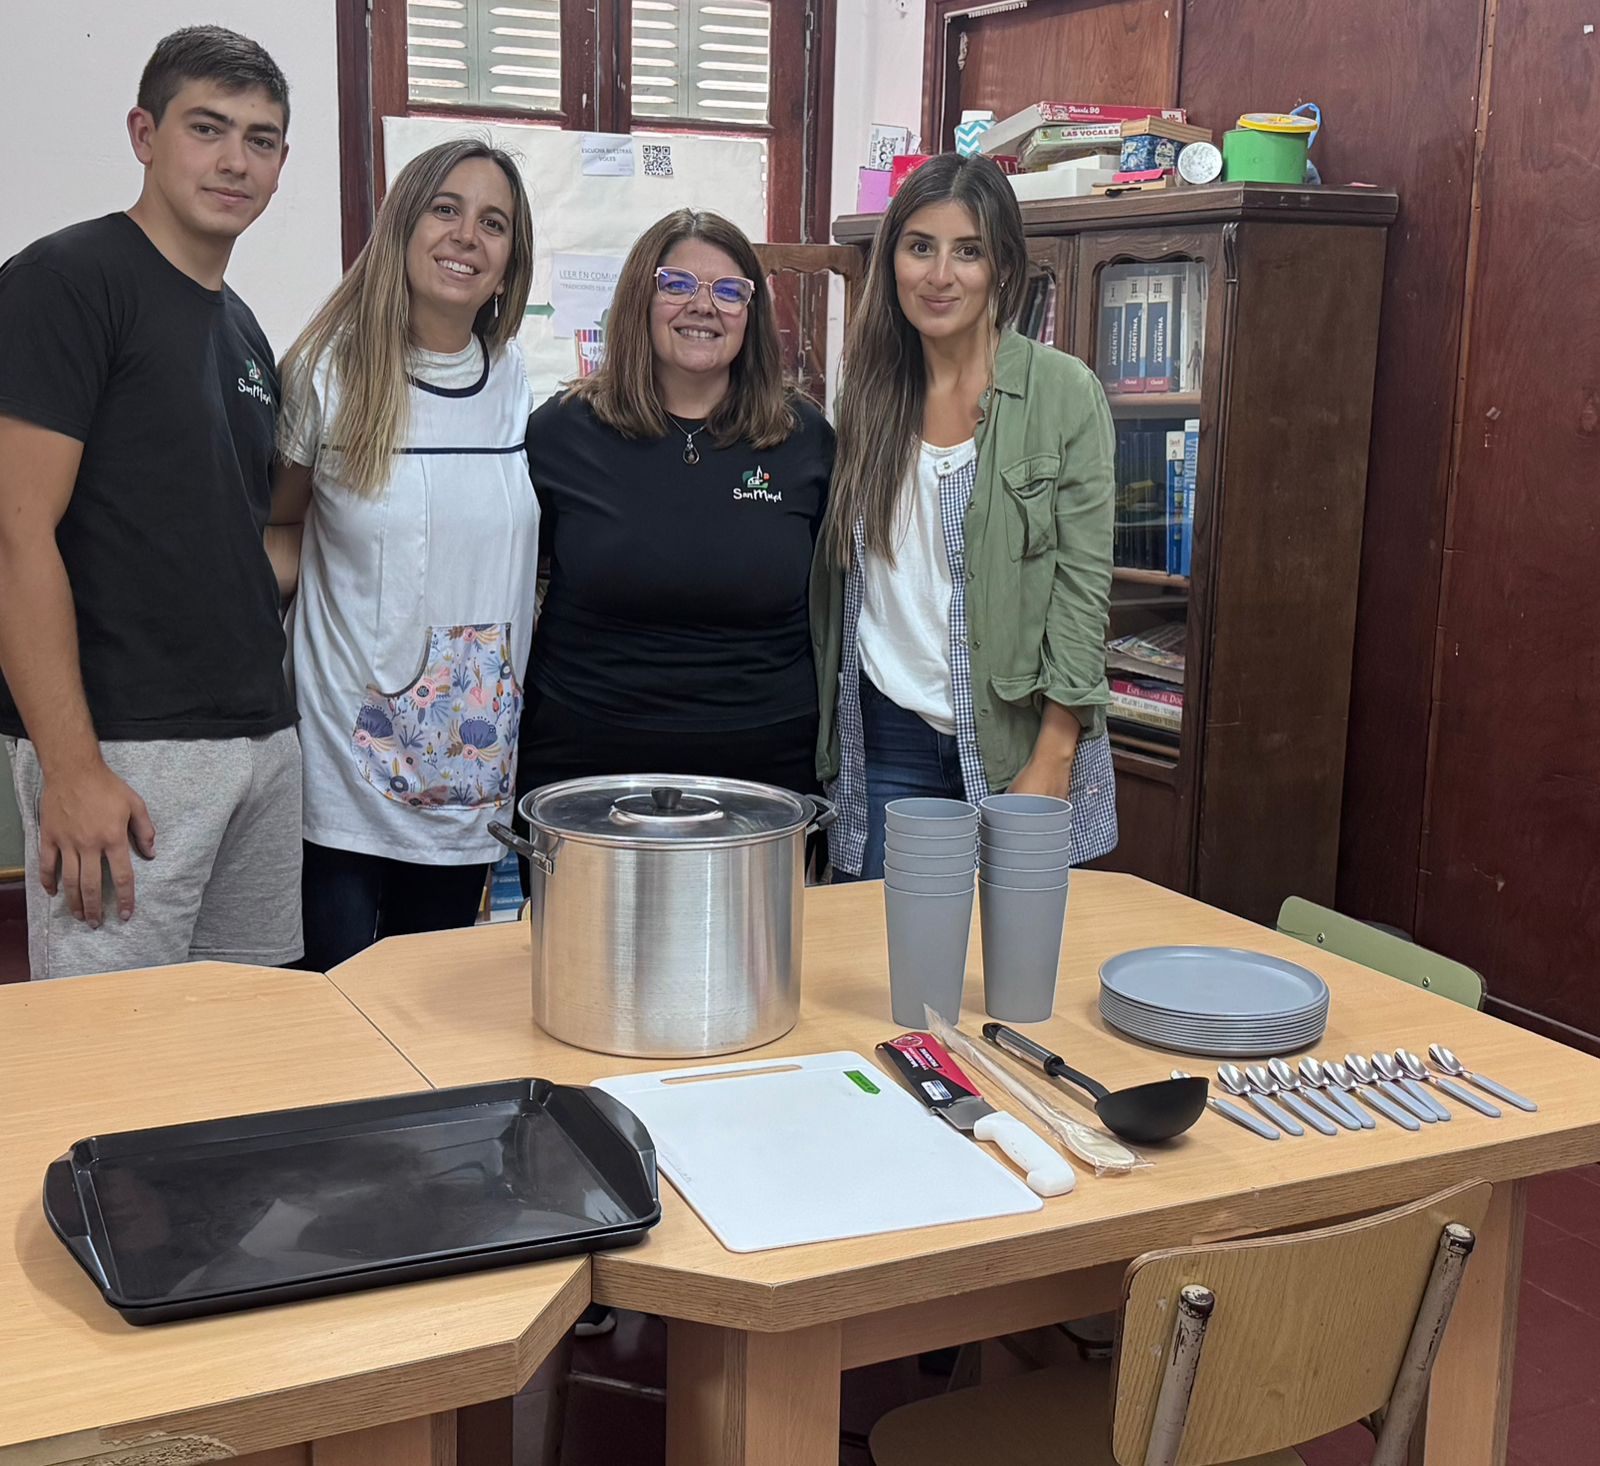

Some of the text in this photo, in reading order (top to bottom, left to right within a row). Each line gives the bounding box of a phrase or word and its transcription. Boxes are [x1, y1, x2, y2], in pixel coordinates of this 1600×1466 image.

[559, 270, 577, 278] LEER
[1111, 321, 1119, 366] ARGENTINA
[1131, 317, 1139, 363] ARGENTINA
[1184, 437, 1199, 487] VISUAL
